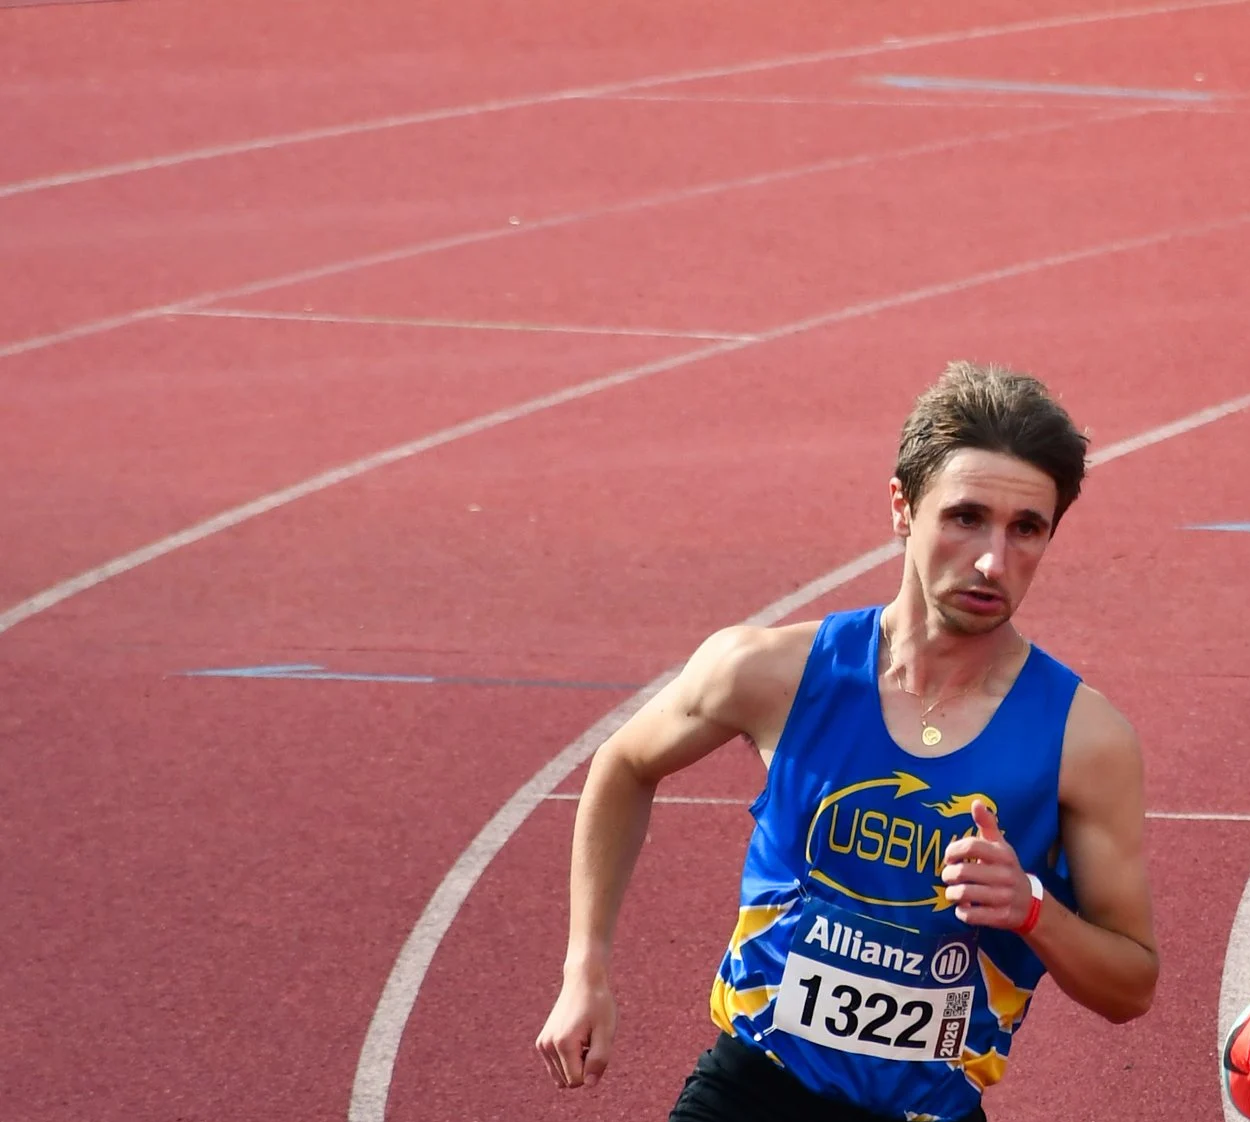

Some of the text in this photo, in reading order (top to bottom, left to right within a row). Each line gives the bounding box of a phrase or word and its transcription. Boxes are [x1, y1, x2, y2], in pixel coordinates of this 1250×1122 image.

[804, 914, 924, 976] Allianz
[798, 973, 934, 1049] 1322
[940, 1021, 960, 1056] 2026
